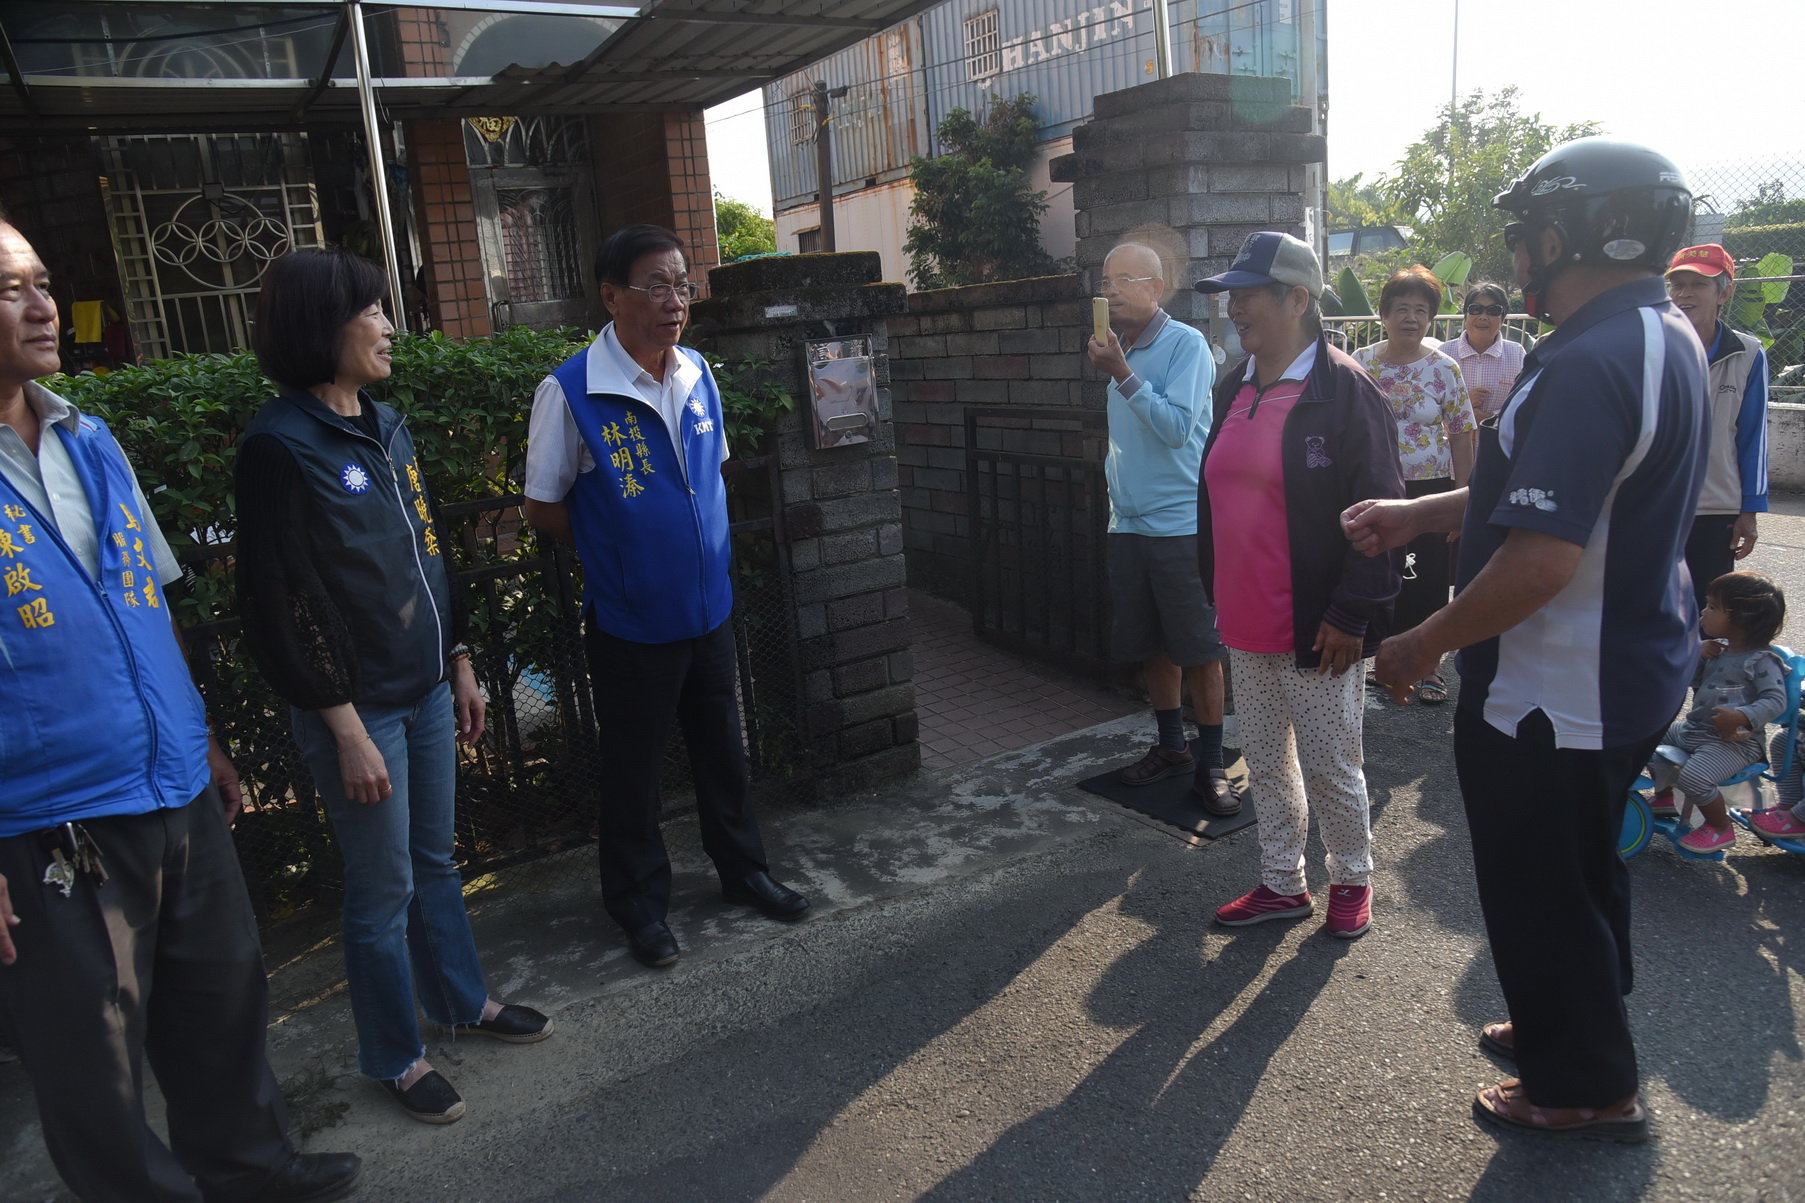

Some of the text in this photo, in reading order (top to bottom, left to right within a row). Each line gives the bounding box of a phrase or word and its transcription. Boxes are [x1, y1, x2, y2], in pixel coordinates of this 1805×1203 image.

[1002, 0, 1133, 72] HANJIN
[601, 421, 645, 499] 林明溱
[624, 410, 656, 475] 南投縣長
[693, 420, 714, 435] KMT
[3, 504, 36, 544] 秘書
